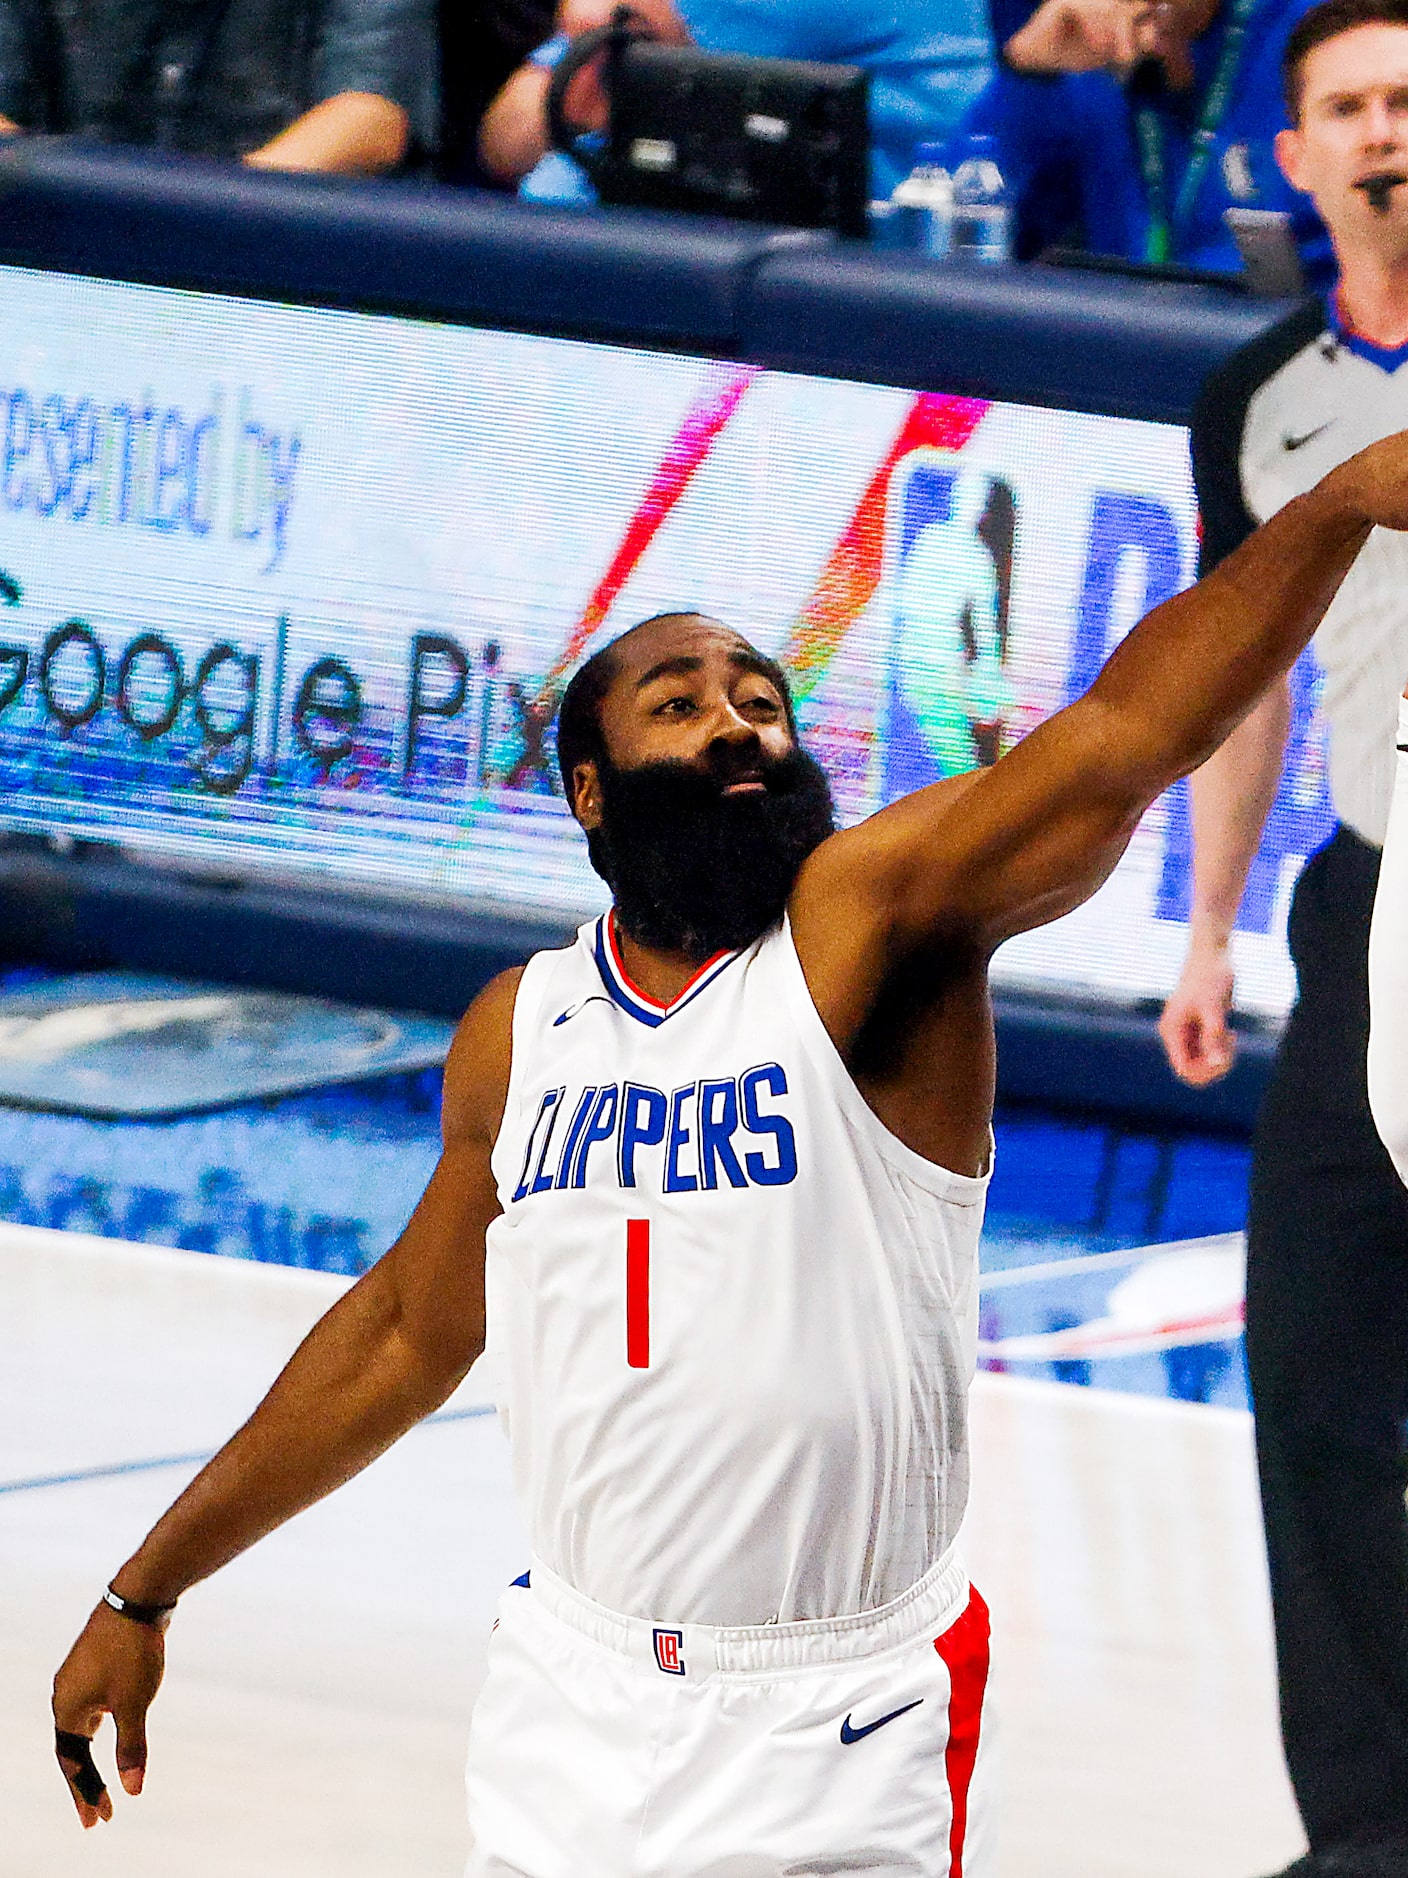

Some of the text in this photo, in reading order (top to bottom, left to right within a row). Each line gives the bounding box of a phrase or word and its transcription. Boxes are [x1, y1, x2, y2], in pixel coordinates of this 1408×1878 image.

[0, 385, 303, 576] esented by
[403, 630, 563, 792] Pix
[511, 1062, 798, 1202] CLIPPERS
[626, 1219, 649, 1369] 1
